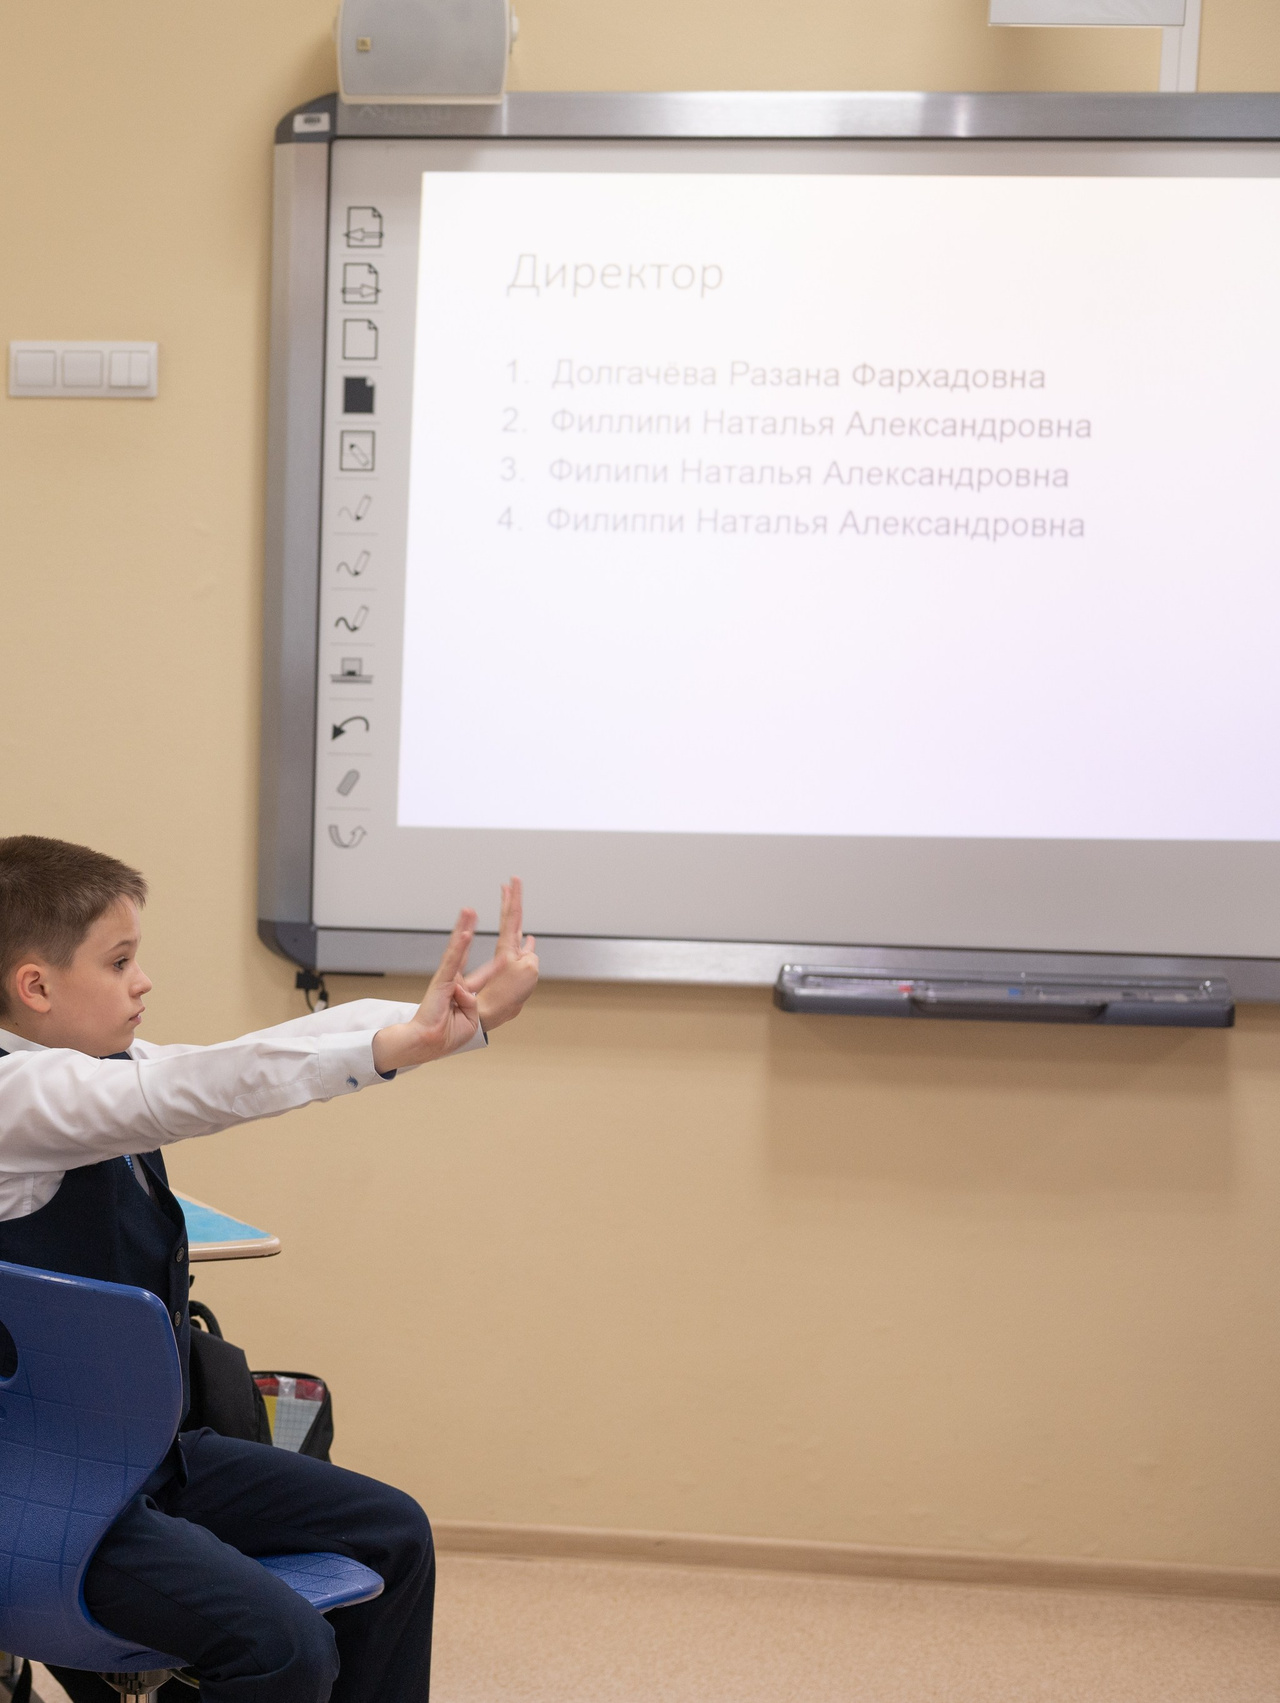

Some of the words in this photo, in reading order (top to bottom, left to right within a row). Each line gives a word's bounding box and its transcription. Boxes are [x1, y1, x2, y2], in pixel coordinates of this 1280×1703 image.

[505, 253, 724, 299] Директор
[506, 358, 529, 384] 1.
[551, 358, 717, 390] Долгачёва
[729, 360, 841, 388] Разана
[851, 361, 1046, 395] Фархадовна
[501, 406, 527, 433] 2.
[551, 407, 691, 435] Филлипи
[703, 409, 835, 437] Наталья
[844, 409, 1092, 445] Александровна
[500, 456, 525, 482] 3.
[548, 457, 669, 484] Филипи
[680, 458, 812, 486] Наталья
[822, 459, 1070, 494] Александровна
[496, 505, 523, 531] 4.
[546, 506, 685, 533] Филиппи
[696, 508, 829, 535] Наталья
[838, 509, 1086, 544] Александровна
